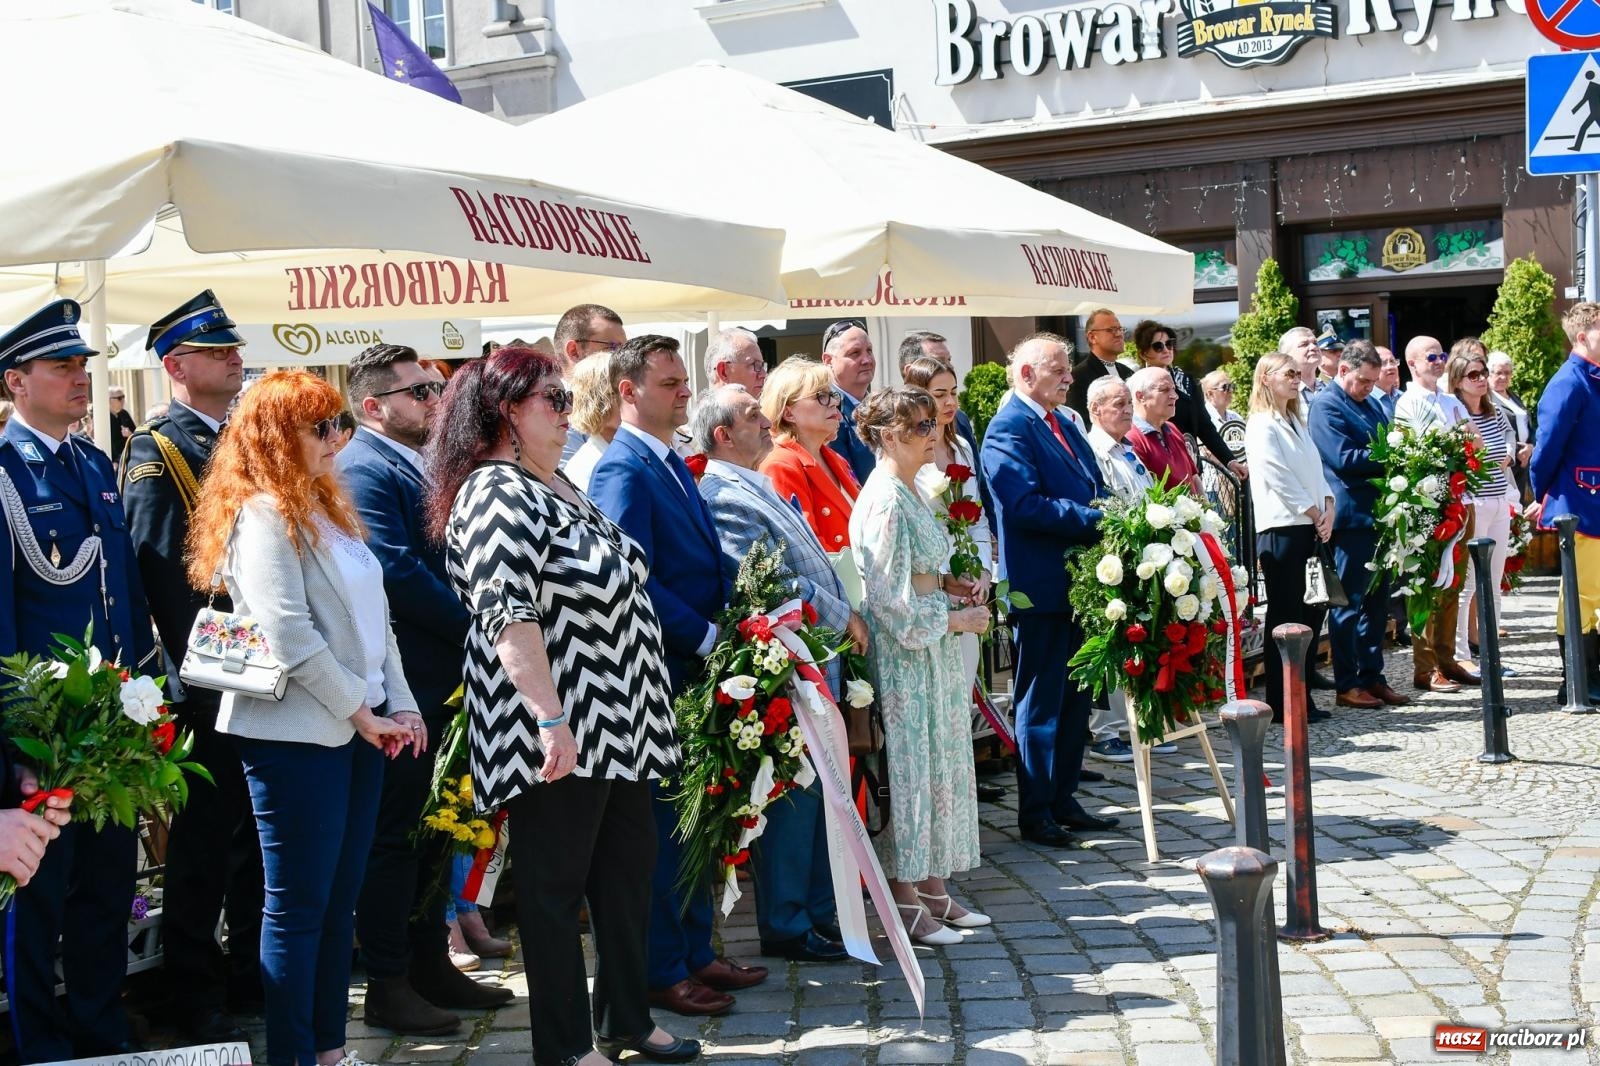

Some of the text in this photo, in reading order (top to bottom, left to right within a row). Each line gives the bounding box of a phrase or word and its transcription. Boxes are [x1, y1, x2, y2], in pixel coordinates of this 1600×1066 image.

[934, 0, 1176, 86] Browar
[1192, 17, 1256, 46] Browar
[1259, 4, 1316, 36] Rynek
[1236, 38, 1273, 55] AD 2013
[449, 186, 652, 264] RACIBORSKIE
[1020, 244, 1119, 293] RACIBORSKIE
